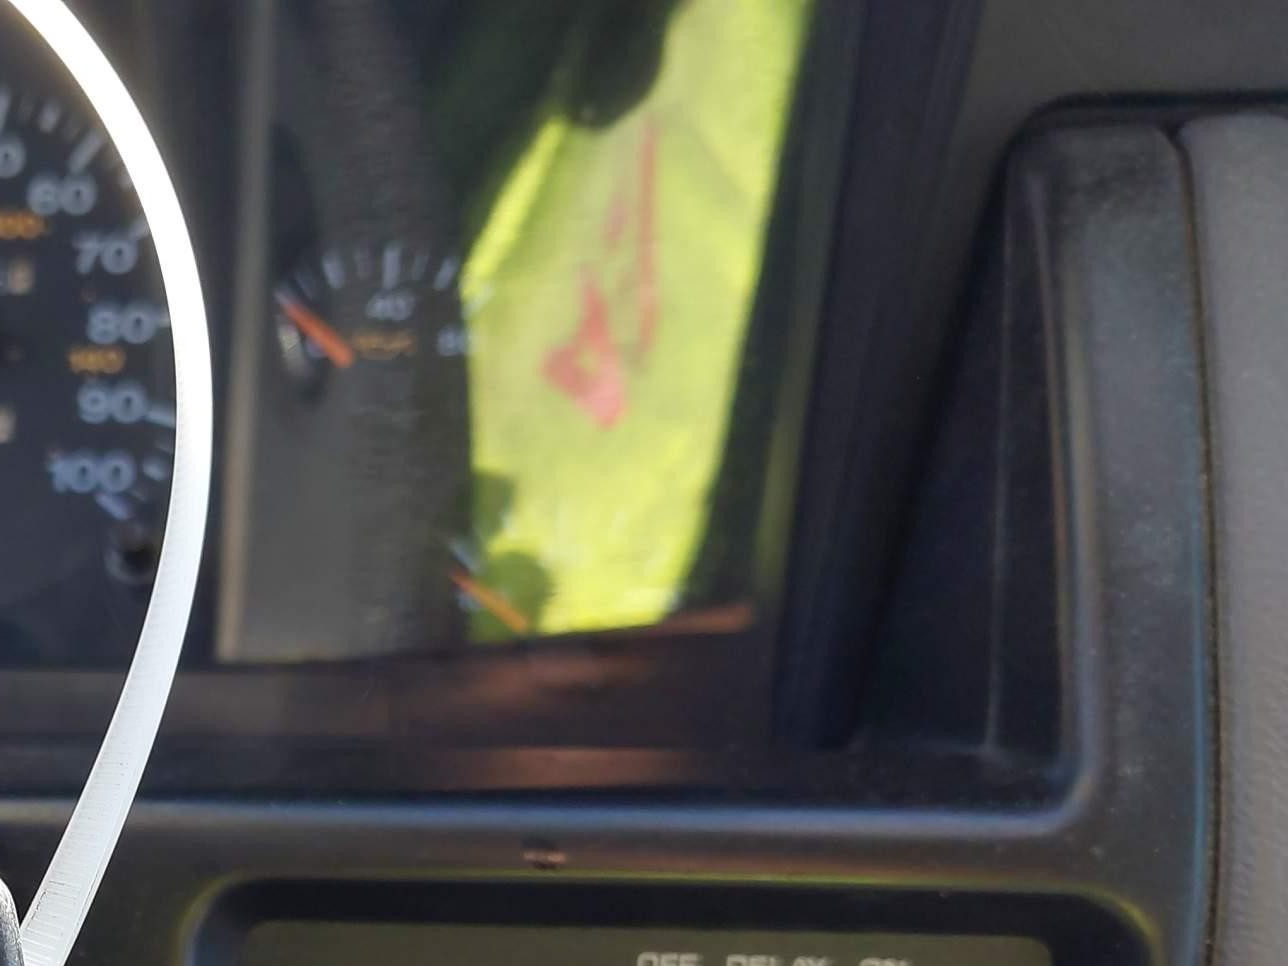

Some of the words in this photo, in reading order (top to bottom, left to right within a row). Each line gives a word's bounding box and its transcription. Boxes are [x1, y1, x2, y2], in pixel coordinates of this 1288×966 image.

[28, 173, 97, 215] 60
[72, 232, 137, 275] 70
[88, 303, 155, 344] 80
[78, 384, 146, 425] 90
[49, 453, 136, 493] 100
